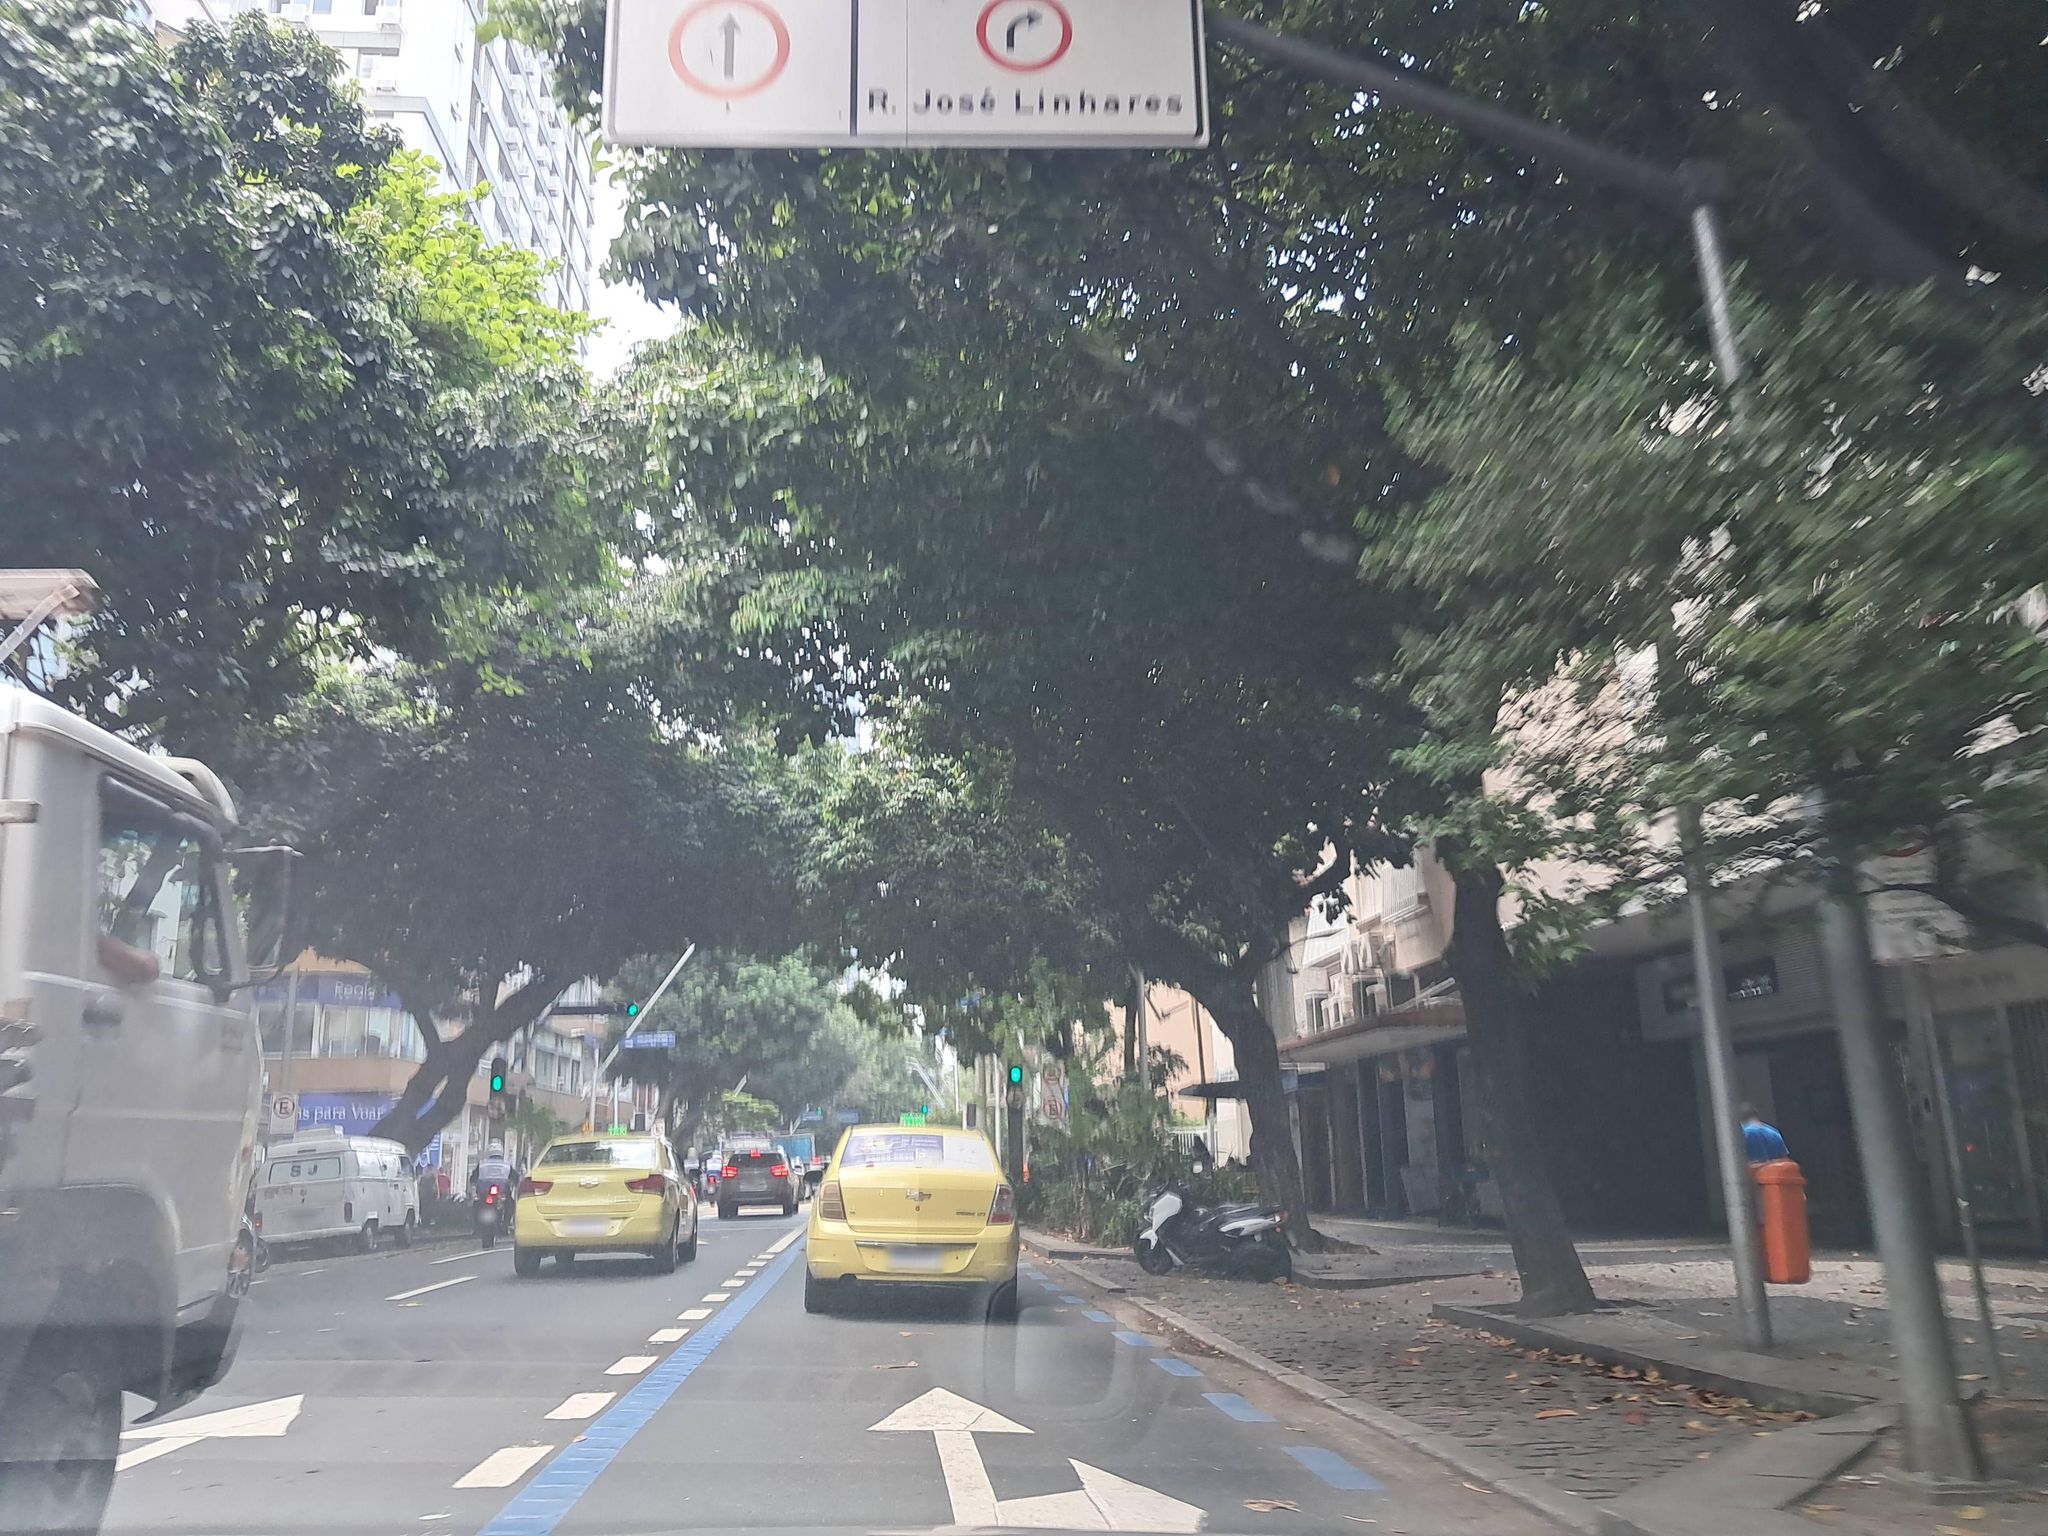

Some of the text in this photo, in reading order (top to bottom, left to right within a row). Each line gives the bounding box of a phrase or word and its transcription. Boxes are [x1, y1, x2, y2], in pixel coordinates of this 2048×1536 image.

[868, 86, 1183, 116] R. José Linhares
[279, 1101, 290, 1115] E
[314, 1105, 346, 1125] para
[351, 1103, 384, 1121] Voar
